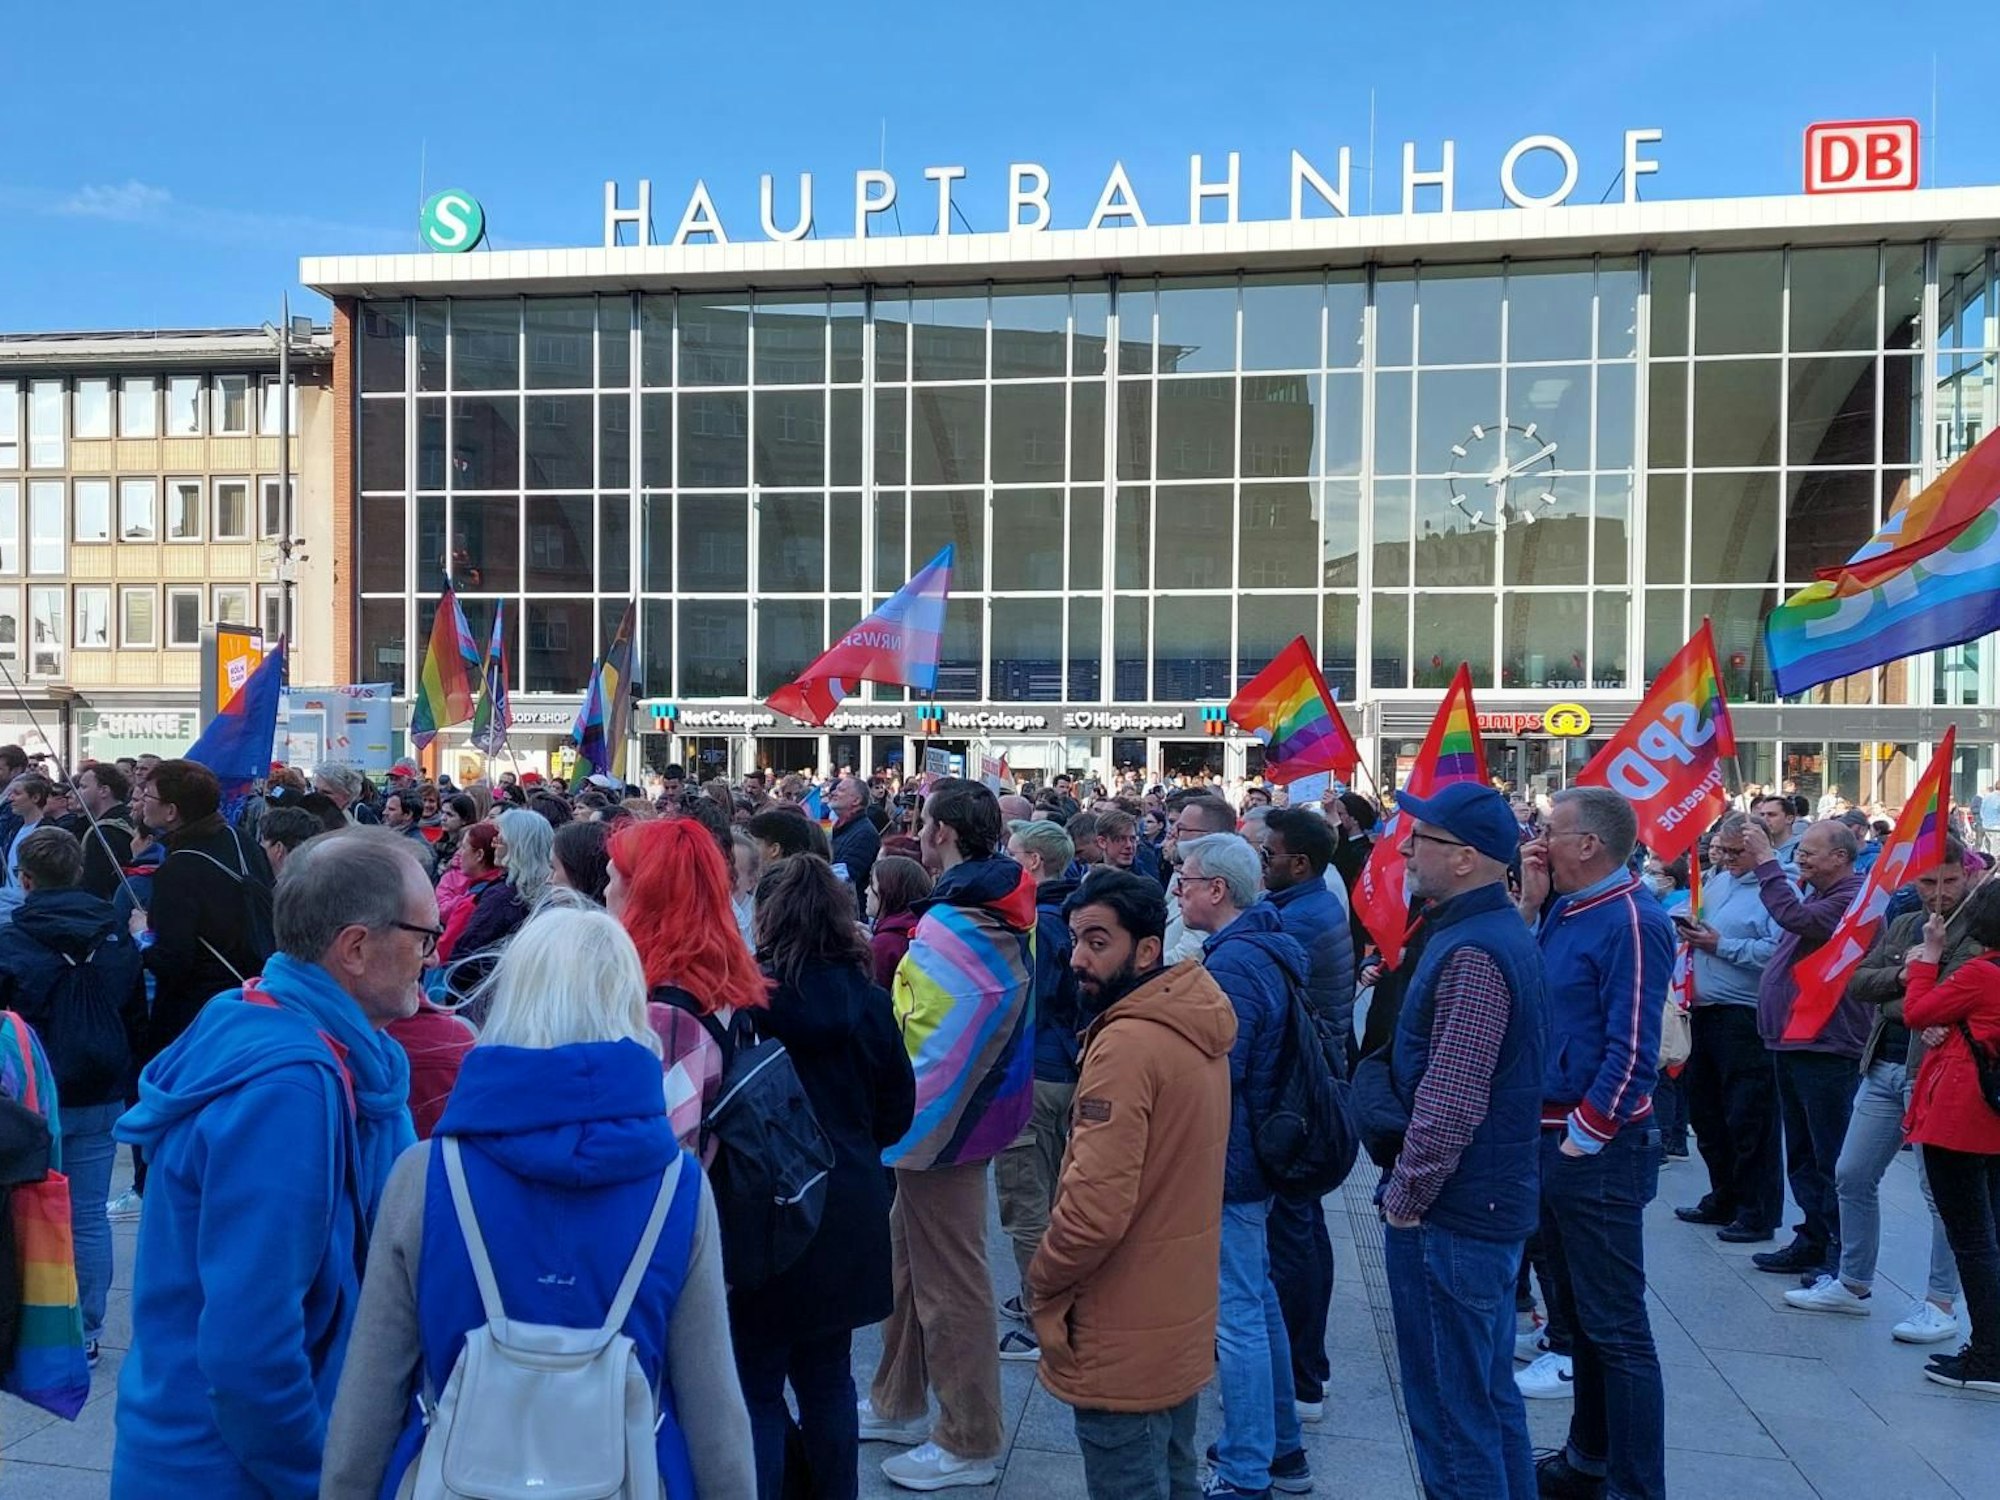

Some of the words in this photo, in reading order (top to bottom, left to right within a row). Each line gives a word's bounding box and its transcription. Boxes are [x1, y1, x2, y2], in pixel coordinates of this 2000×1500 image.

[1819, 133, 1906, 184] DB
[603, 128, 1663, 247] HAUPTBAHNHOF
[428, 194, 473, 248] S
[97, 713, 180, 735] CHANGE
[539, 711, 570, 723] SHOP
[681, 710, 774, 729] NetCologne
[826, 712, 903, 730] ighspeed
[948, 711, 1045, 730] NetCologne
[1093, 712, 1183, 730] Highspeed
[1477, 712, 1541, 735] amps
